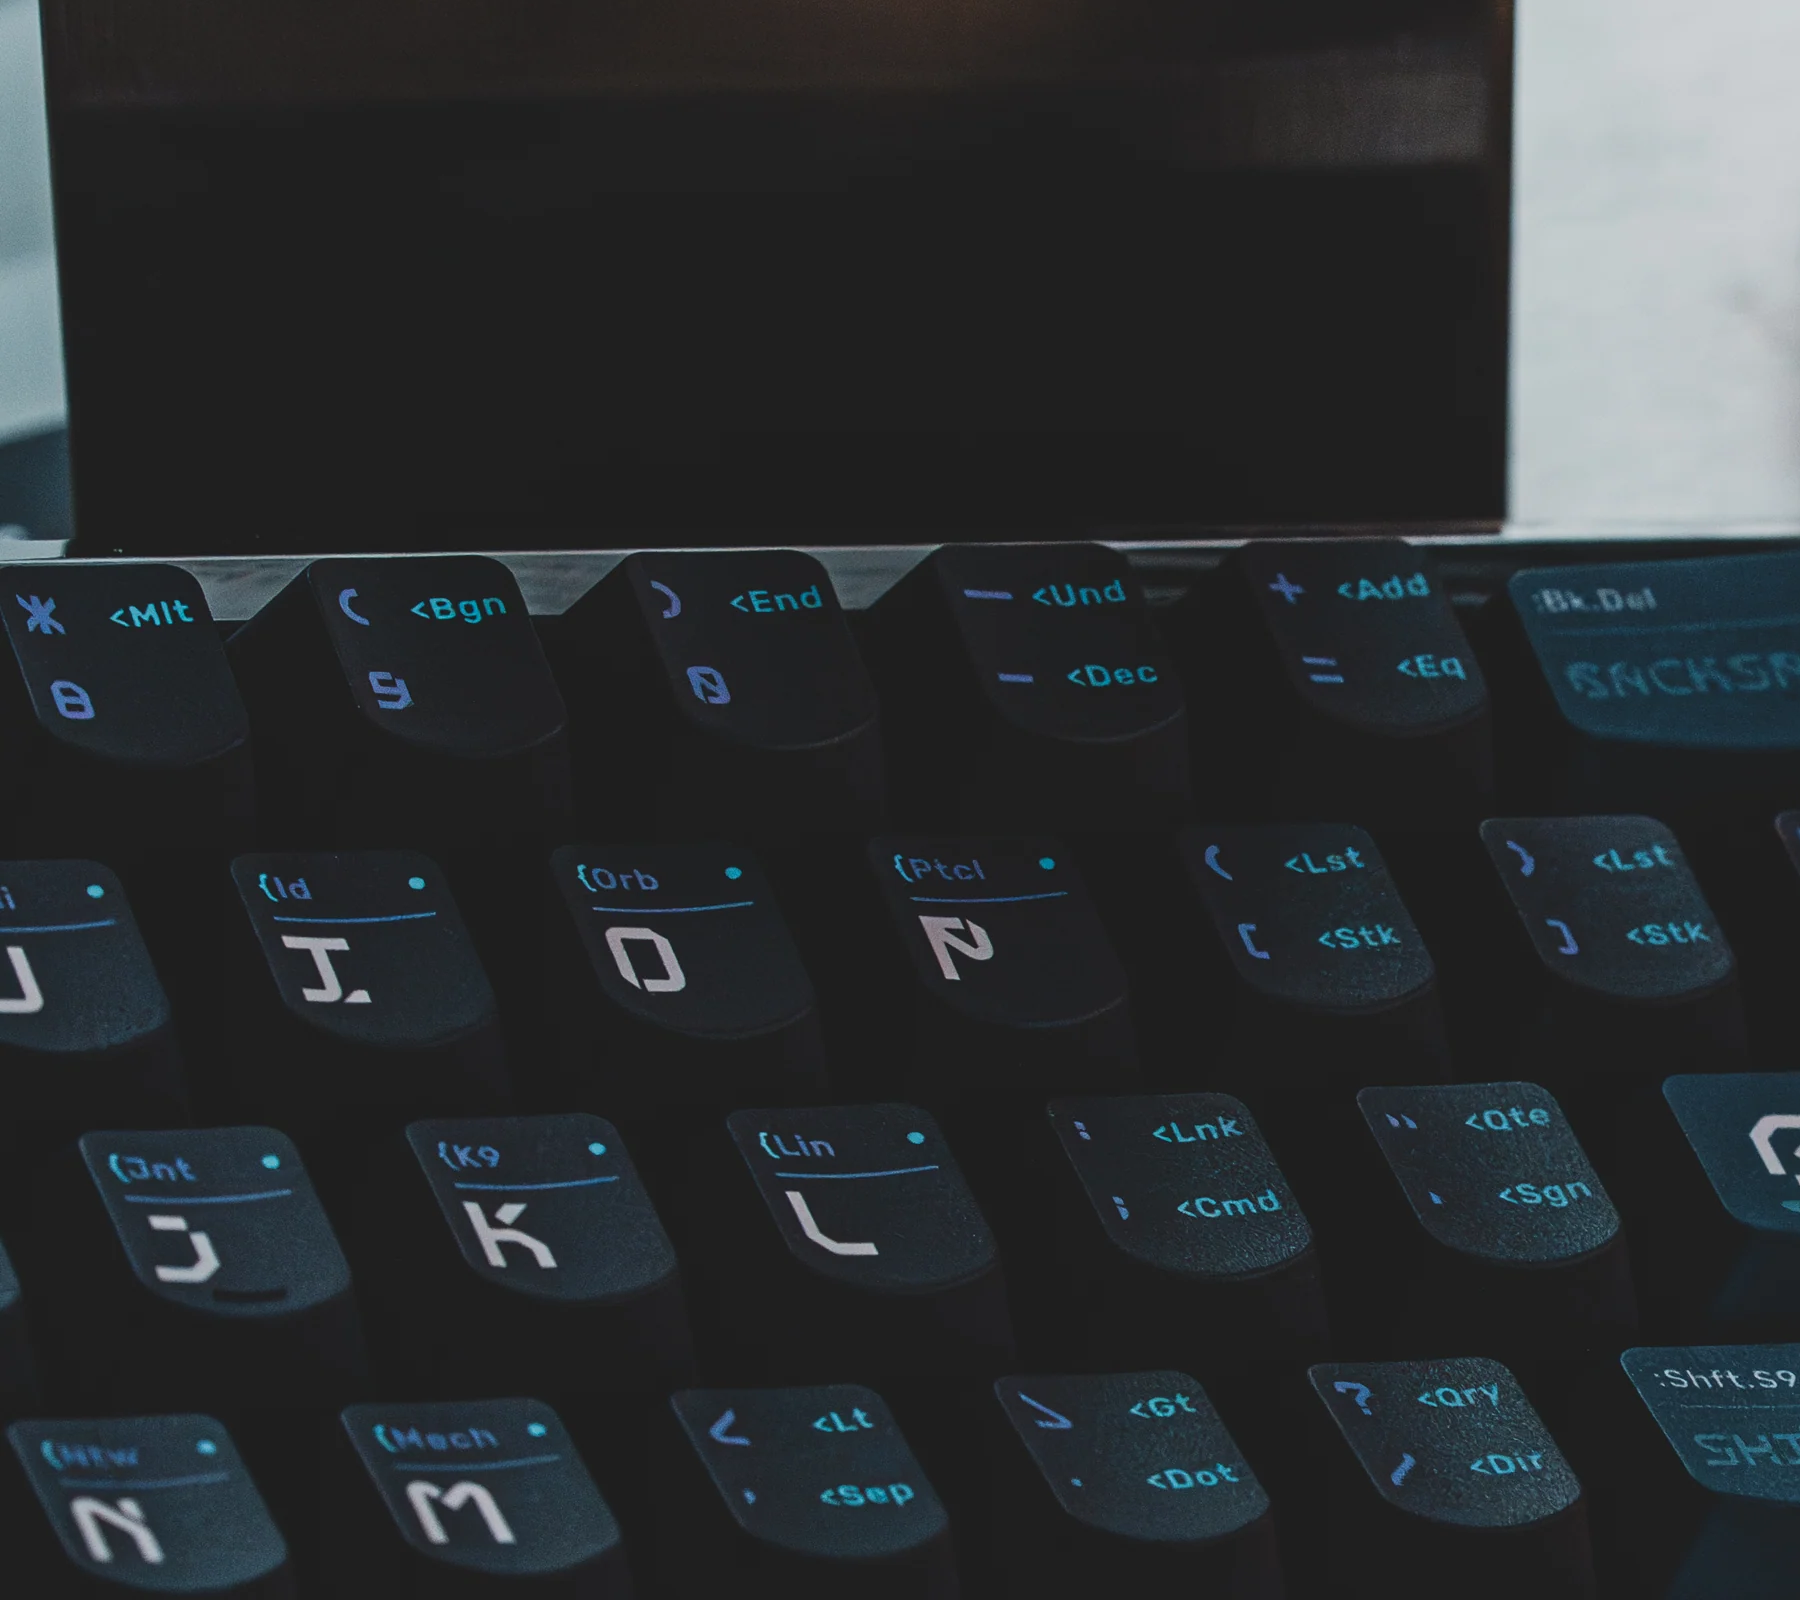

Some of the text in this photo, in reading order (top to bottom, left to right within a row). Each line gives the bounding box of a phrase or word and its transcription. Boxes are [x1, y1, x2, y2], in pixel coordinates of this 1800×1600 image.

[369, 671, 413, 710] 9
[462, 1201, 557, 1269] K
[784, 1191, 880, 1256] L
[72, 1496, 164, 1564] N
[406, 1480, 515, 1544] M
